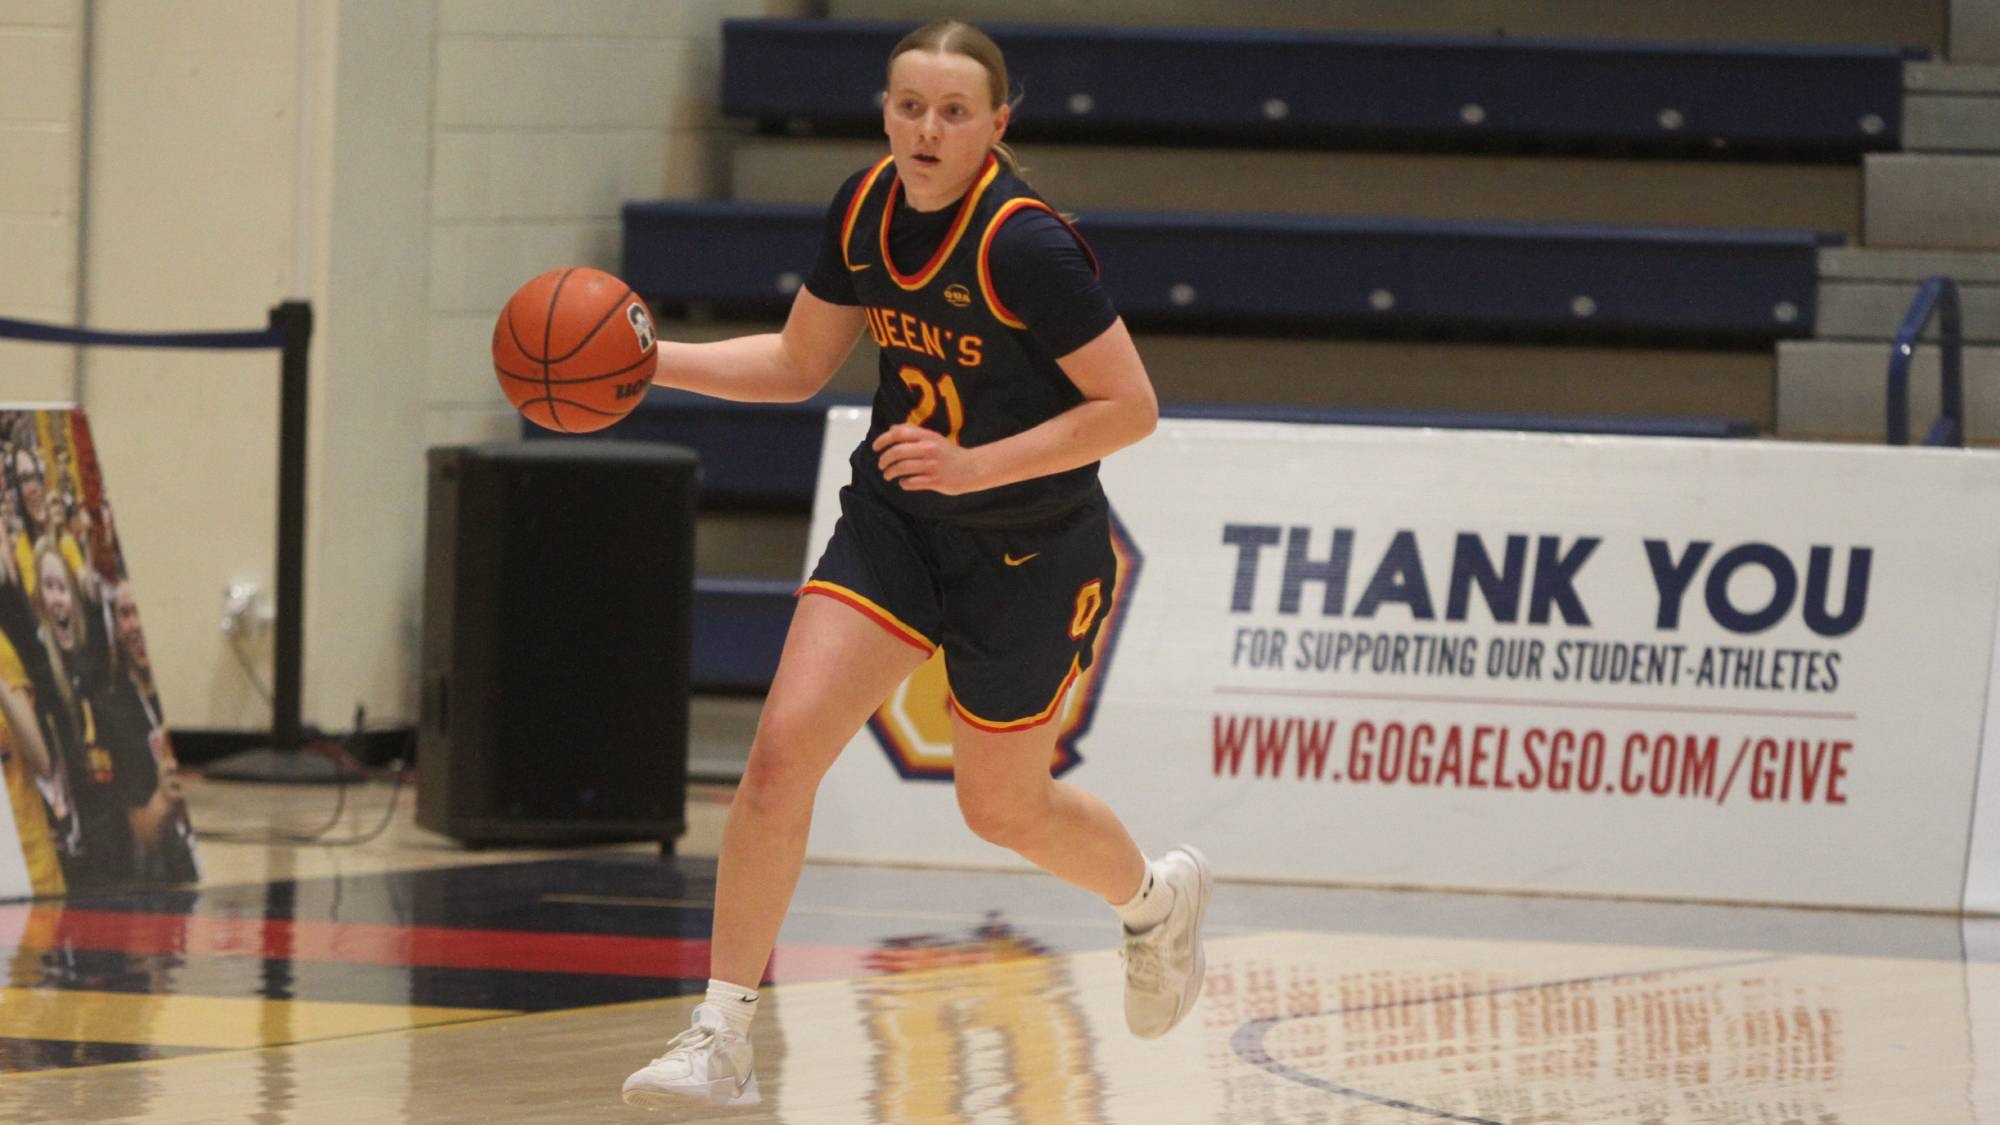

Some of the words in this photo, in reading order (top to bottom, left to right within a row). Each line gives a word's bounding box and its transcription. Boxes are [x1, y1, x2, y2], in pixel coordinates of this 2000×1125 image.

[865, 305, 983, 367] UEEN'S
[898, 365, 965, 447] 21
[1222, 522, 1603, 627] THANK
[1643, 539, 1873, 637] YOU
[1233, 628, 1288, 669] FOR
[1295, 630, 1477, 679] SUPPORTING
[1488, 638, 1543, 681] OUR
[1553, 641, 1842, 694] STUDENT-ATHLETES
[1212, 714, 1854, 806] WWW.GOGAELSGO.COM/GIVE
